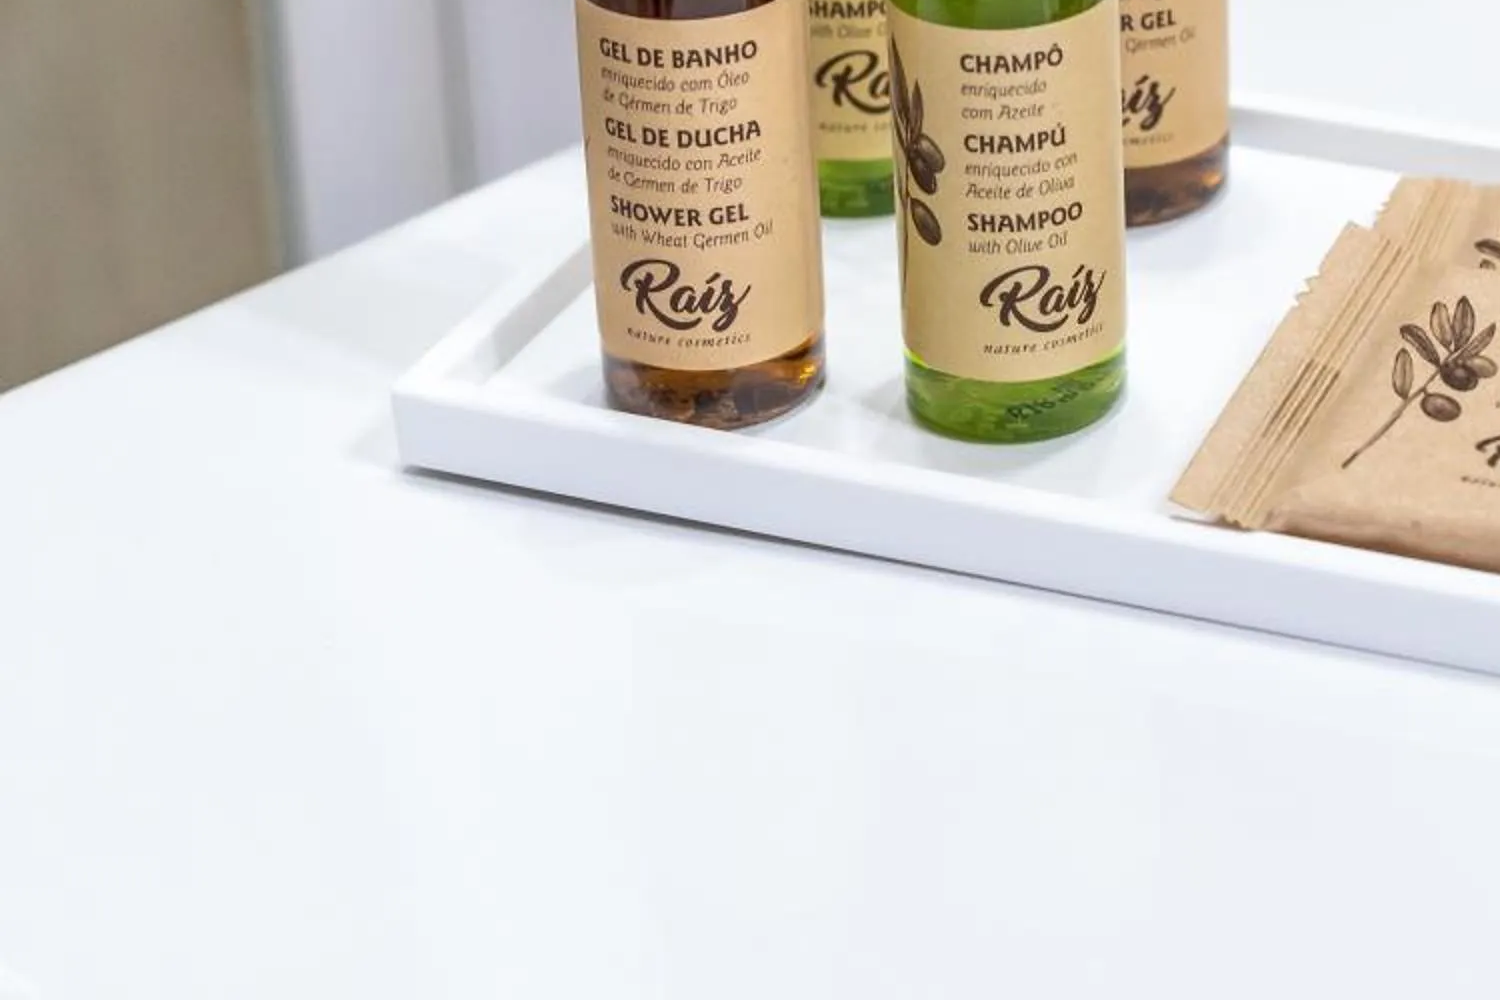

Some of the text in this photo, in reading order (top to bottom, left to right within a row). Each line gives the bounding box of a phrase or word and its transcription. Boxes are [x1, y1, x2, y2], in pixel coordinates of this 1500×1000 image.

[1141, 9, 1177, 31] GEL
[600, 37, 757, 68] GEL DE BANHO
[960, 43, 1063, 74] CHAMPÔ
[602, 67, 750, 92] enriquecido com Óleo
[961, 78, 1047, 100] enriquecido
[675, 99, 693, 114] de
[701, 98, 737, 116] Trigo
[961, 104, 1044, 120] com Azeite
[606, 117, 761, 148] GEL DE DUCHA
[964, 122, 1066, 154] CHAMPÚ
[608, 146, 761, 171] enriquecido con Aceite
[965, 152, 1078, 180] enriquecido con
[608, 168, 620, 180] de
[681, 178, 698, 193] de
[705, 177, 742, 194] Trigo
[965, 175, 1075, 199] Aceite de Oliva
[611, 195, 749, 226] SHOWER GEL
[967, 201, 1083, 233] SHAMPOO
[612, 219, 773, 250] with Wheat Germen Oil
[968, 230, 1068, 255] with Olive Oil
[620, 259, 752, 332] Raíz
[979, 264, 1107, 333] Raíz
